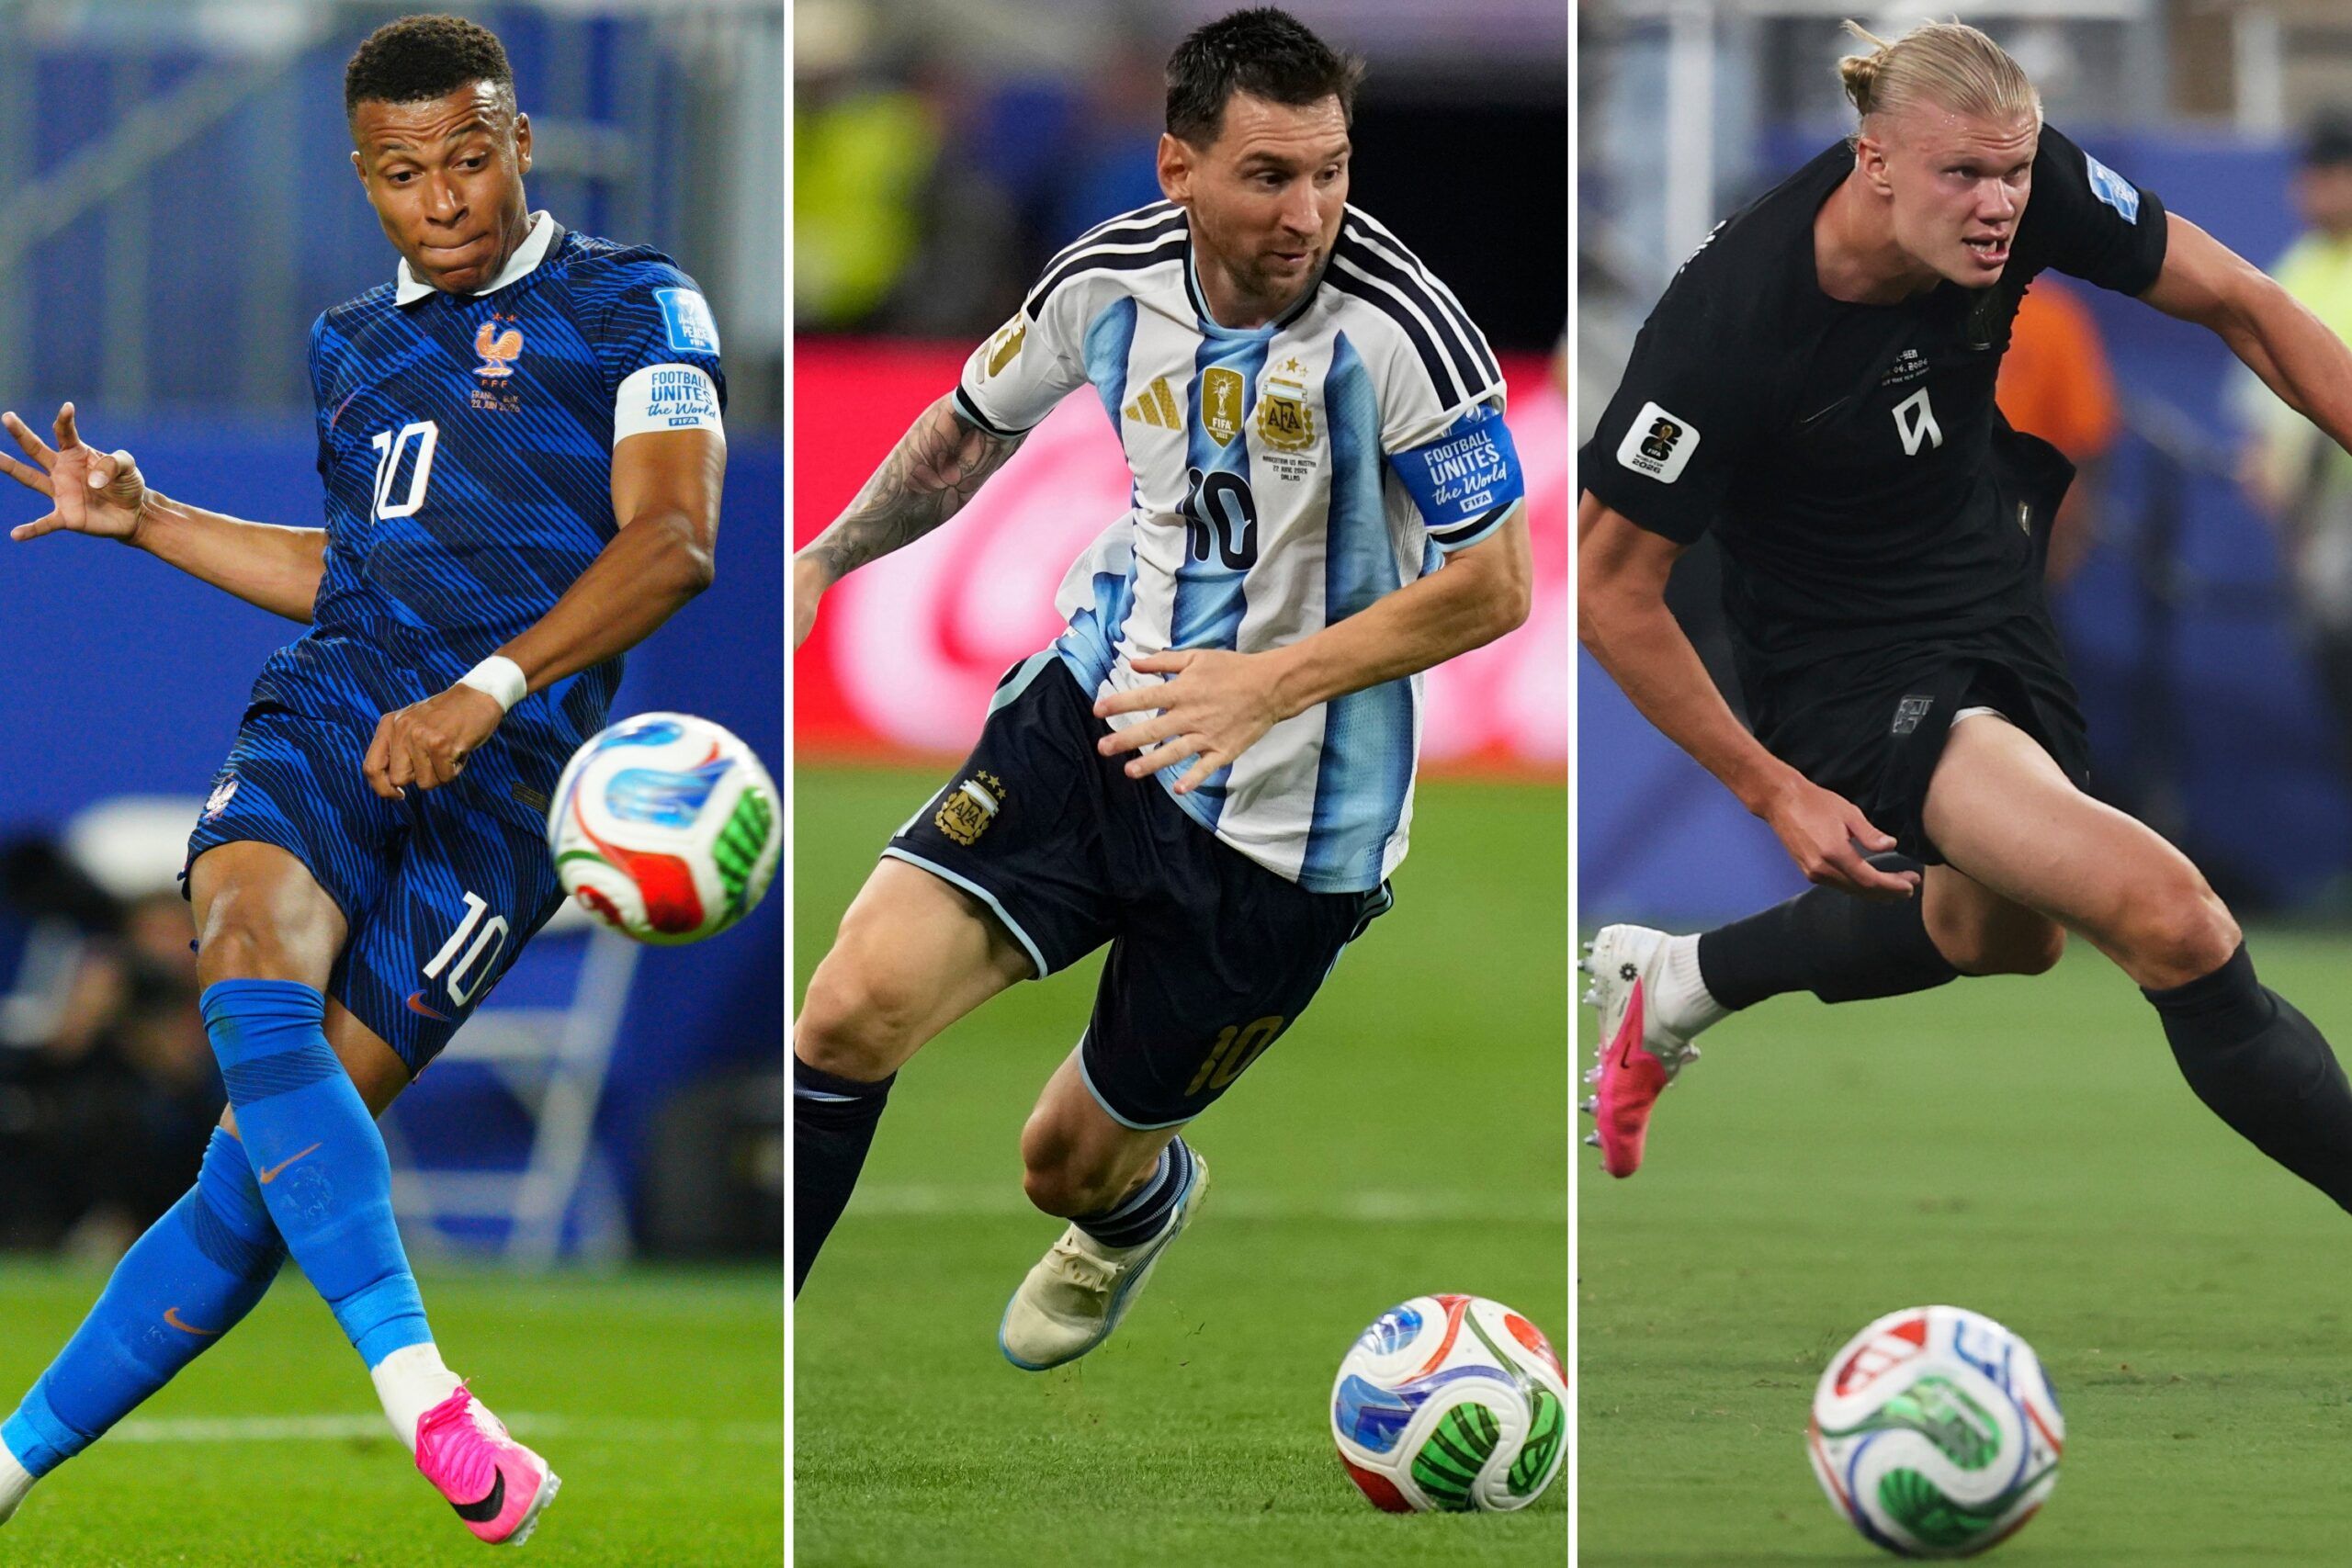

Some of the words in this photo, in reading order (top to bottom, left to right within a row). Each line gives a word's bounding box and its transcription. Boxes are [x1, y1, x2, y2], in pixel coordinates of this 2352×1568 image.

[651, 370, 707, 389] FOOTBALL
[651, 385, 713, 405] UNITES
[645, 403, 672, 417] the
[675, 402, 716, 420] World
[672, 417, 697, 425] FIFA
[1212, 417, 1231, 431] FIFA
[1268, 399, 1301, 434] AFA
[1892, 386, 1943, 456] 9
[1424, 429, 1492, 467] FOOTBALL
[1430, 443, 1500, 486] UNITES
[1632, 457, 1661, 474] 2026
[371, 419, 438, 525] 10
[1431, 485, 1462, 506] the
[1463, 461, 1507, 494] World
[1182, 467, 1258, 571] 10
[1464, 492, 1490, 510] FIFA
[422, 890, 509, 1007] 10
[1184, 1016, 1283, 1097] 10
